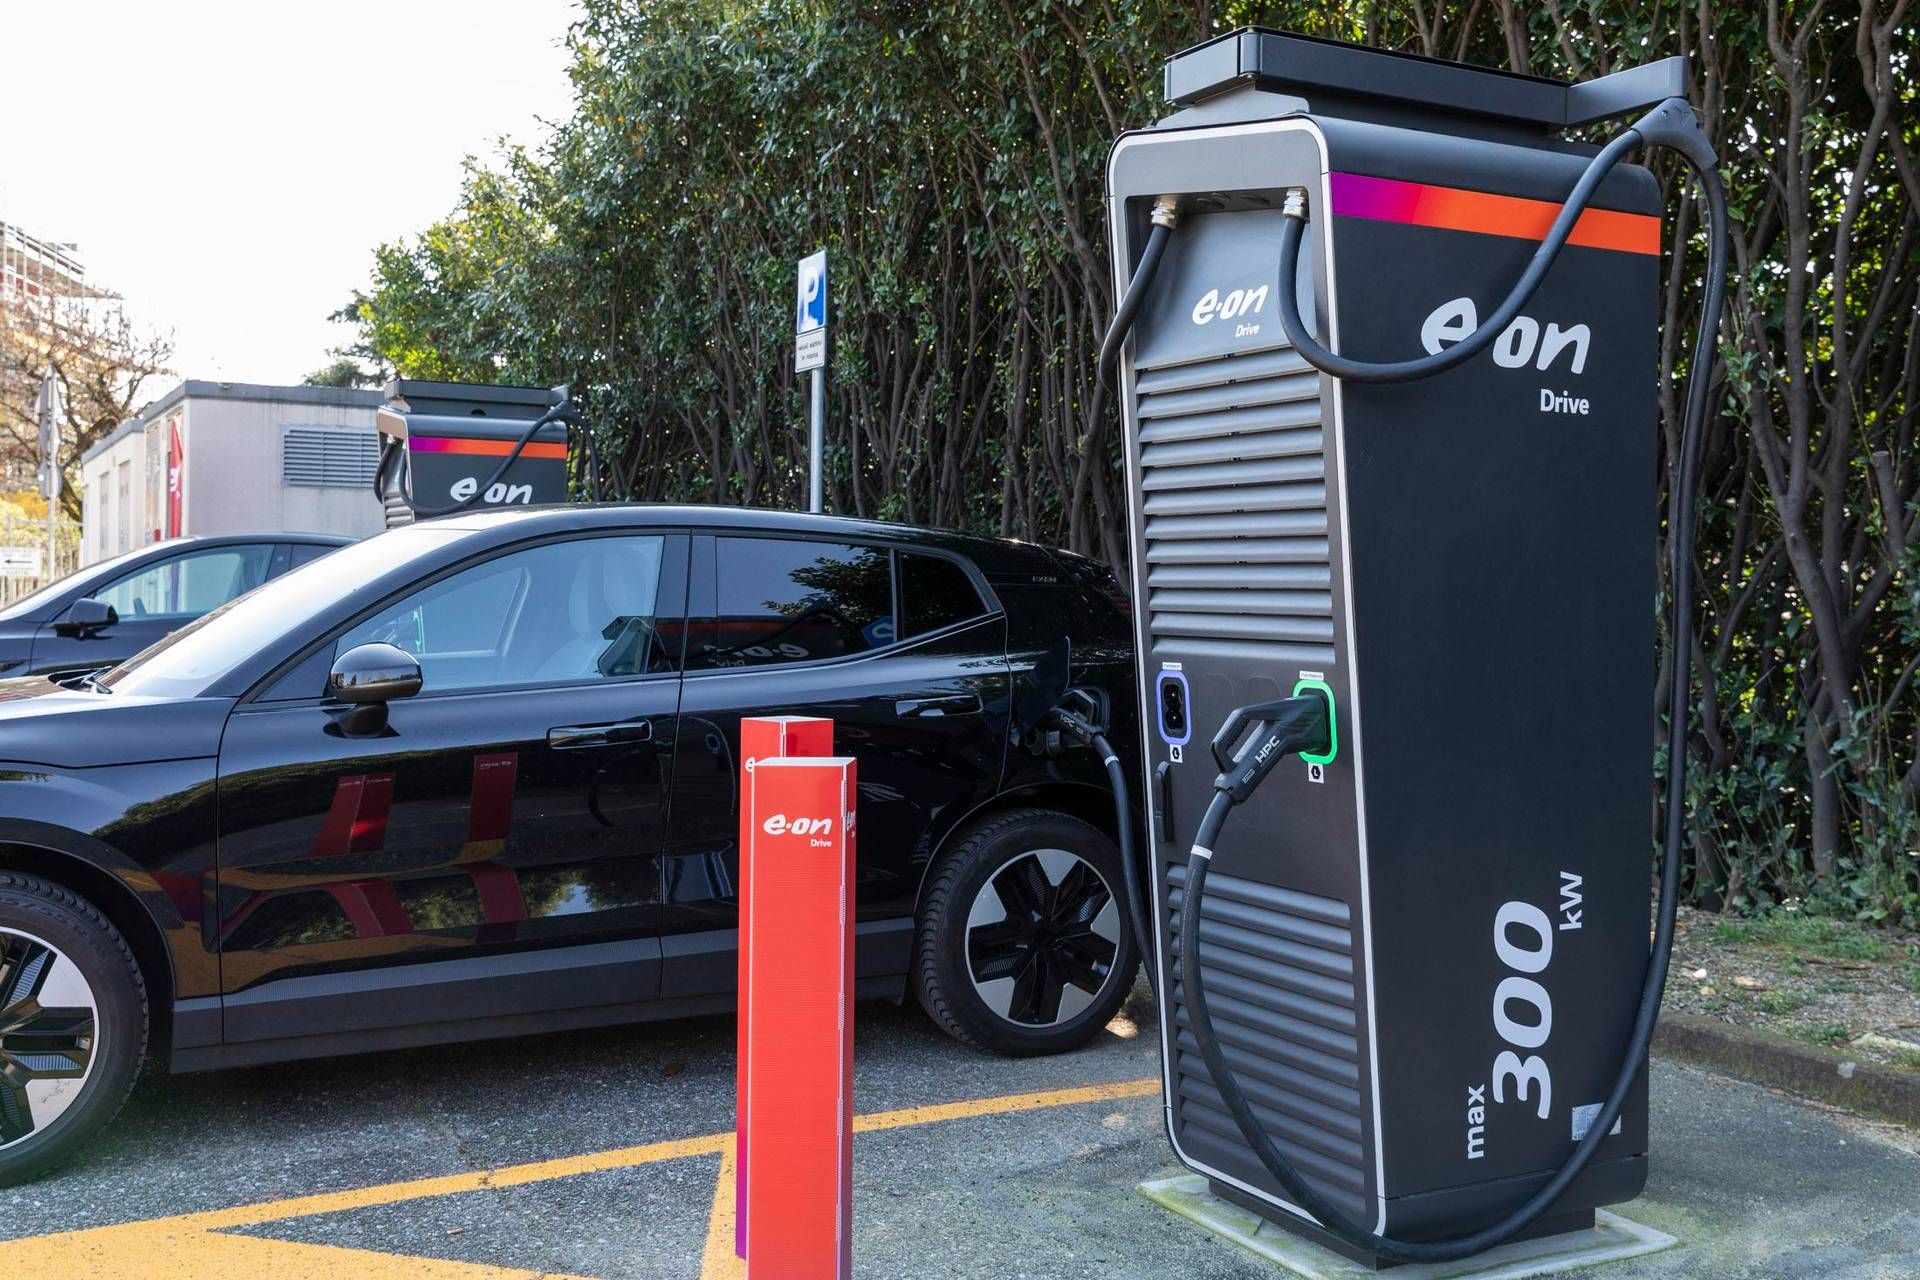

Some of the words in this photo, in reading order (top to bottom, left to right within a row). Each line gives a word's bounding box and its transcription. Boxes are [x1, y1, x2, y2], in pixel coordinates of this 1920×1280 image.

[1235, 323, 1260, 338] Drive
[1540, 388, 1590, 415] Drive
[1254, 735, 1280, 763] HPC
[810, 838, 832, 847] Drive
[1559, 871, 1583, 931] kW
[1493, 902, 1553, 1120] 300
[1467, 1084, 1486, 1160] max
